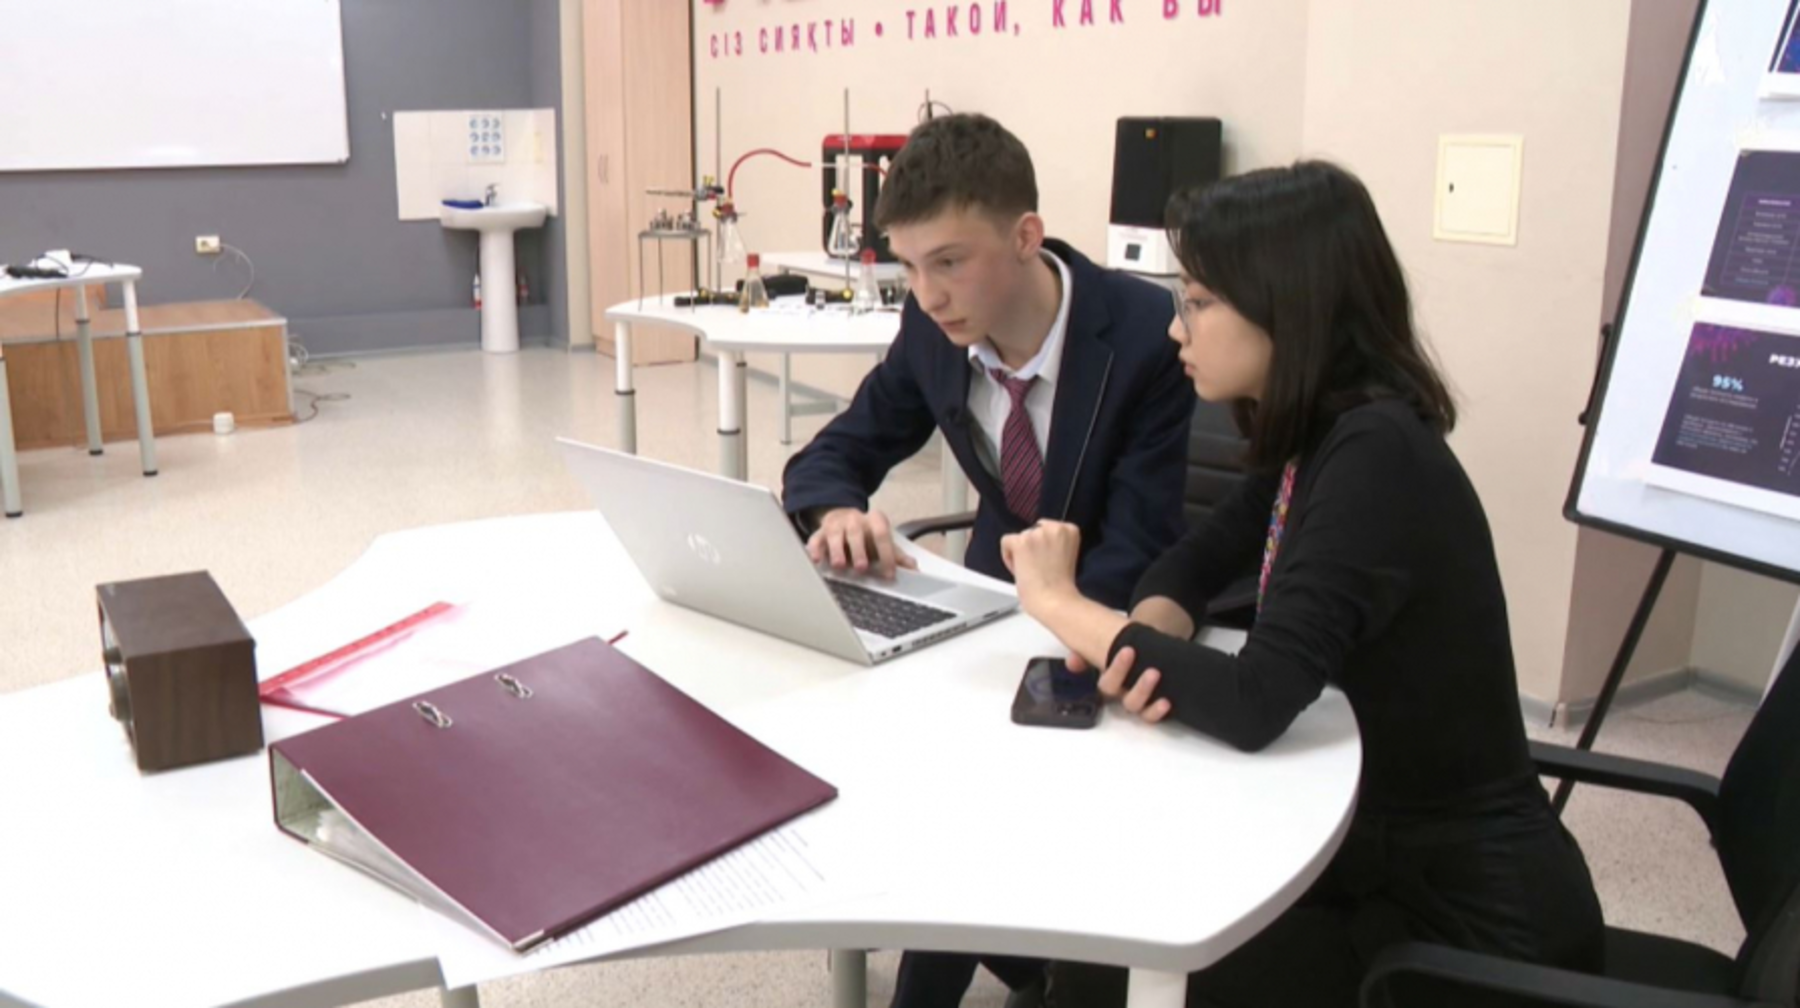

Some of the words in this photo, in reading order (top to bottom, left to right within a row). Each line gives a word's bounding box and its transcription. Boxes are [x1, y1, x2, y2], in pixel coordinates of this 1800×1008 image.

[710, 30, 742, 59] СІЗ
[759, 18, 854, 53] СИЯҚТЫ
[1052, 0, 1124, 28] КАК
[1712, 374, 1743, 392] 95%
